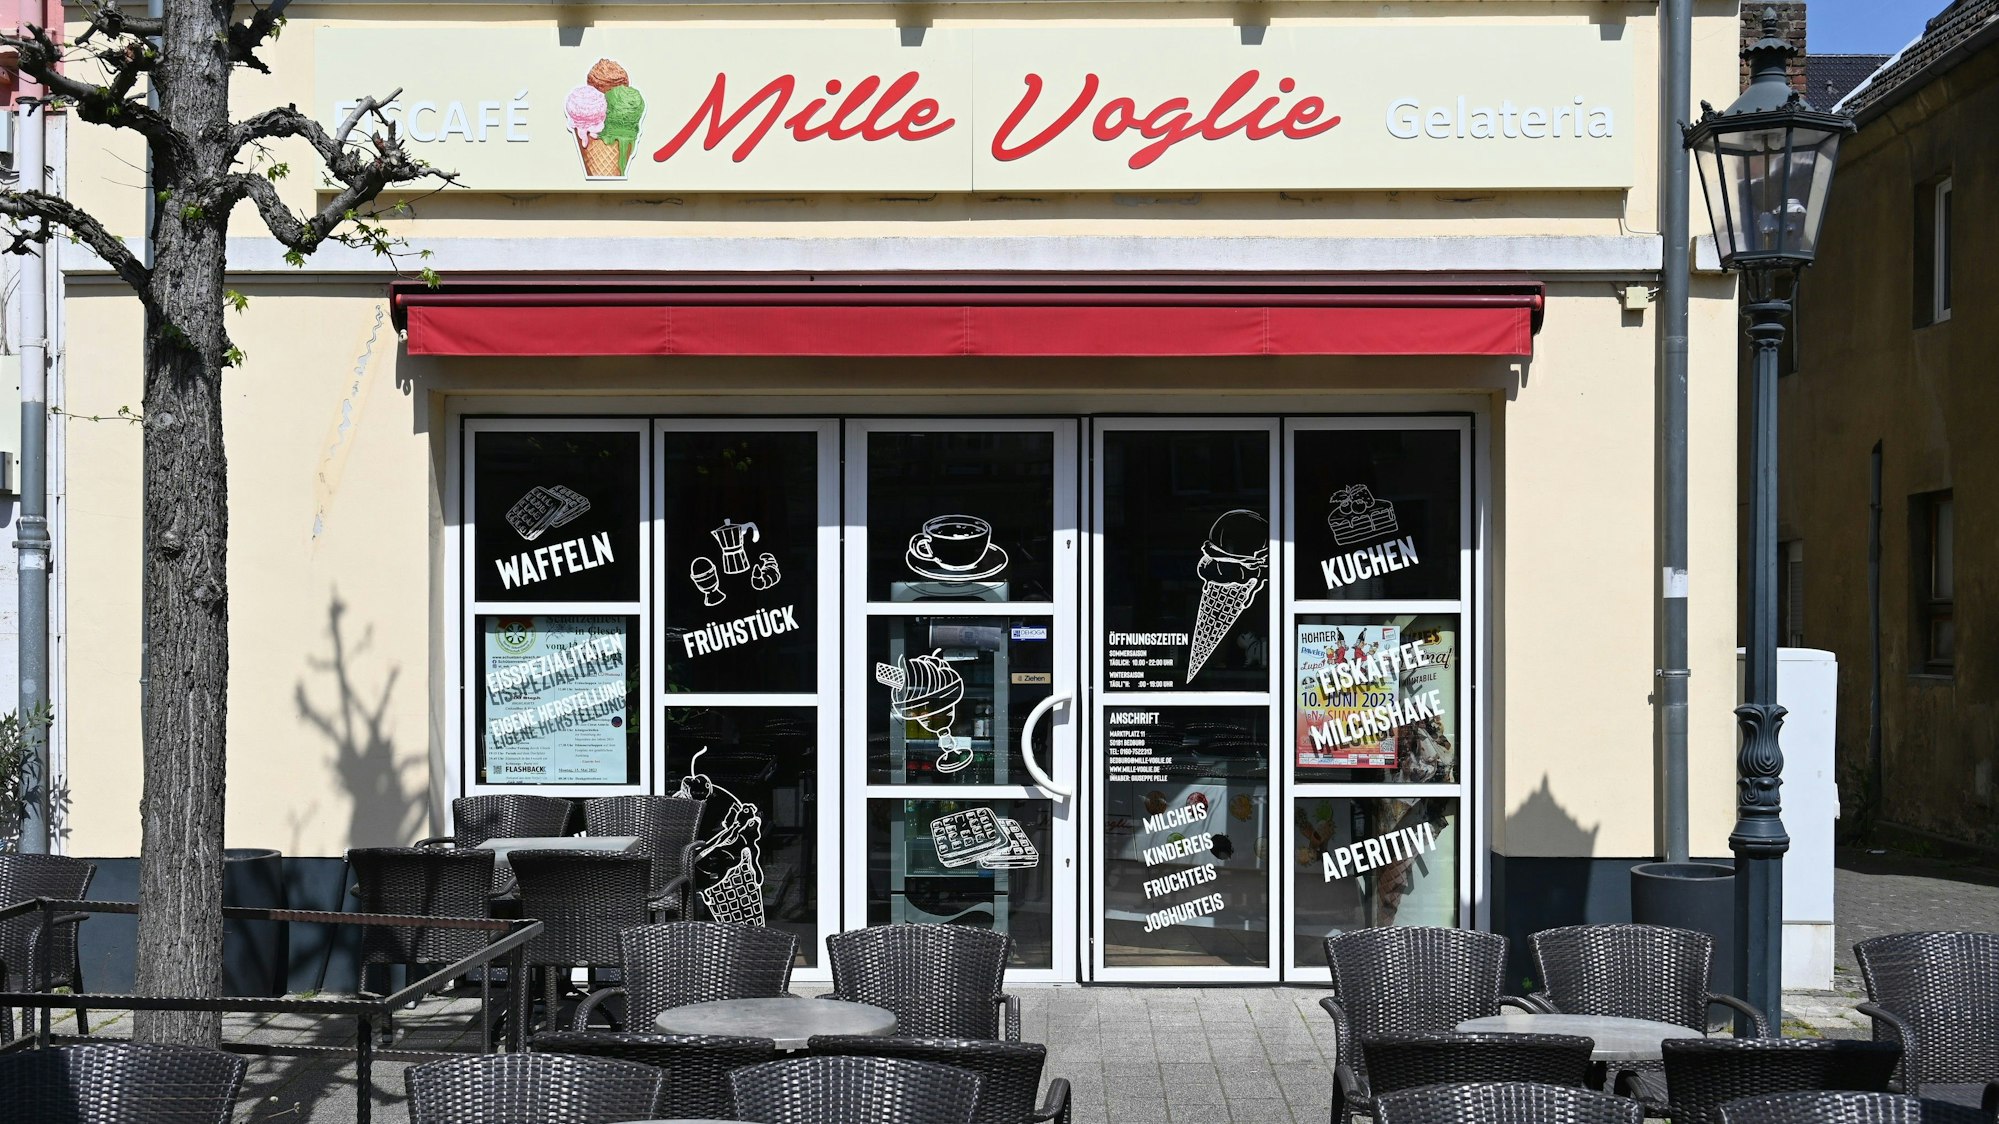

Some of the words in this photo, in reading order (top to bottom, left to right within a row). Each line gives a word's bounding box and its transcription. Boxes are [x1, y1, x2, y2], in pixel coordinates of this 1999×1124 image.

[653, 71, 956, 163] Mille
[991, 69, 1342, 170] Voglie
[1385, 94, 1615, 140] Gelateria
[495, 531, 615, 590] WAFFELN
[1320, 535, 1420, 590] KUCHEN
[682, 604, 800, 659] FRÜHSTÜCK
[1108, 630, 1189, 646] ÖFFNUNGSZEITEN
[485, 631, 625, 694] EISSPEZIALITÄTEN
[1108, 649, 1148, 657] SOMMERSAISON
[1163, 658, 1174, 667] UHR
[1317, 639, 1430, 696] EISKAFFEE
[1024, 674, 1046, 682] Ziehen
[1108, 671, 1145, 679] WINTERSAISON
[1163, 680, 1174, 688] UHR
[490, 708, 540, 739] EIGENE
[537, 680, 627, 721] HERSTELLUNG
[1301, 691, 1321, 707] 10.
[1325, 691, 1358, 708] JUNI
[1361, 692, 1395, 708] 2023
[1109, 711, 1160, 725] ANSCHRIFT
[1109, 730, 1140, 738] MARKTPLATZ
[1140, 730, 1146, 738] 11
[1311, 689, 1446, 751] MILCHSHAKE
[1124, 739, 1146, 747] BEDBURG
[1109, 765, 1161, 773] WWW.MILLE-VOGLIE.DE
[1131, 774, 1154, 782] GIUSEPPE
[1154, 774, 1169, 782] PELLE
[1142, 802, 1208, 835] MILCHEIS
[1142, 831, 1214, 868] KINDEREIS
[1321, 821, 1437, 883] APERITIVI
[1142, 862, 1217, 900] FRUCHTEIS
[1143, 892, 1225, 933] JOGHURTEIS
